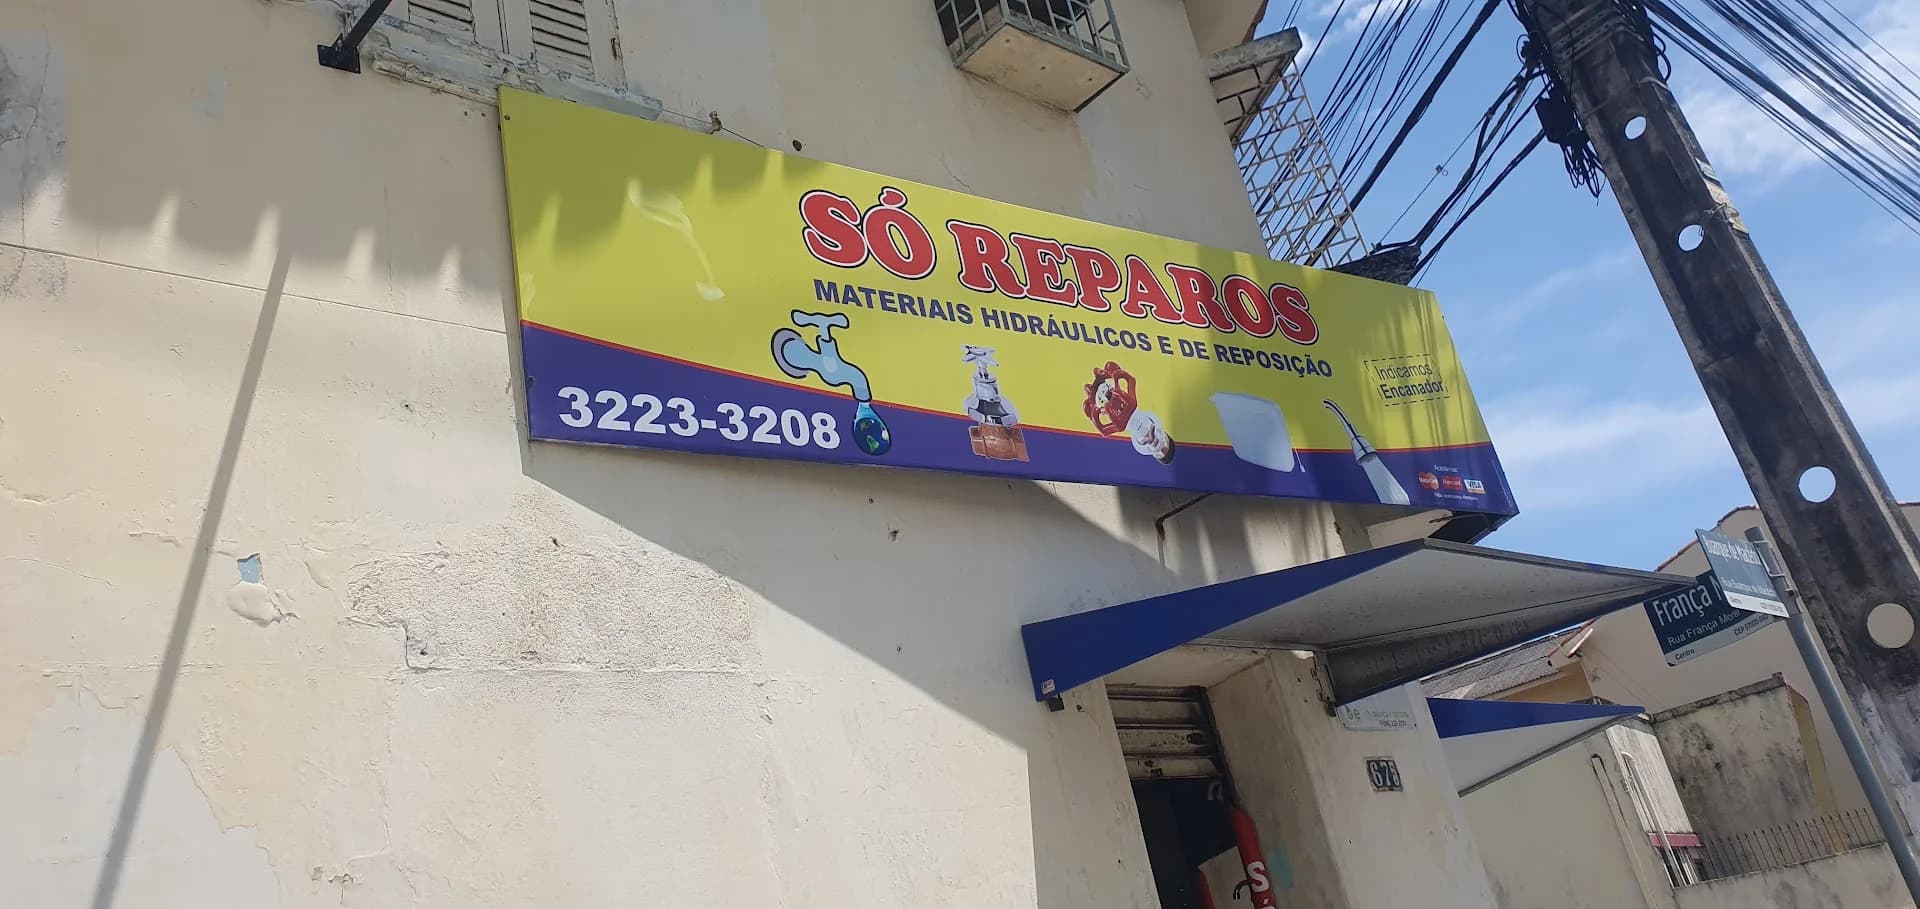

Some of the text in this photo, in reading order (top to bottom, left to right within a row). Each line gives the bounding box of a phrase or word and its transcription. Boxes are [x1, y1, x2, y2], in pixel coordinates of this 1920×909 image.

[800, 186, 1319, 345] SÓ REPAROS
[814, 279, 1333, 378] MATERIAIS HIDRÁULICOS E DE REPOSIÇÃO
[1375, 364, 1433, 380] Indicamos
[1380, 379, 1444, 399] Encanador
[558, 386, 841, 450] 3223-3208
[1652, 586, 1712, 626] França
[1667, 633, 1686, 647] Rua
[1687, 621, 1718, 639] França
[1675, 648, 1695, 661] Centro
